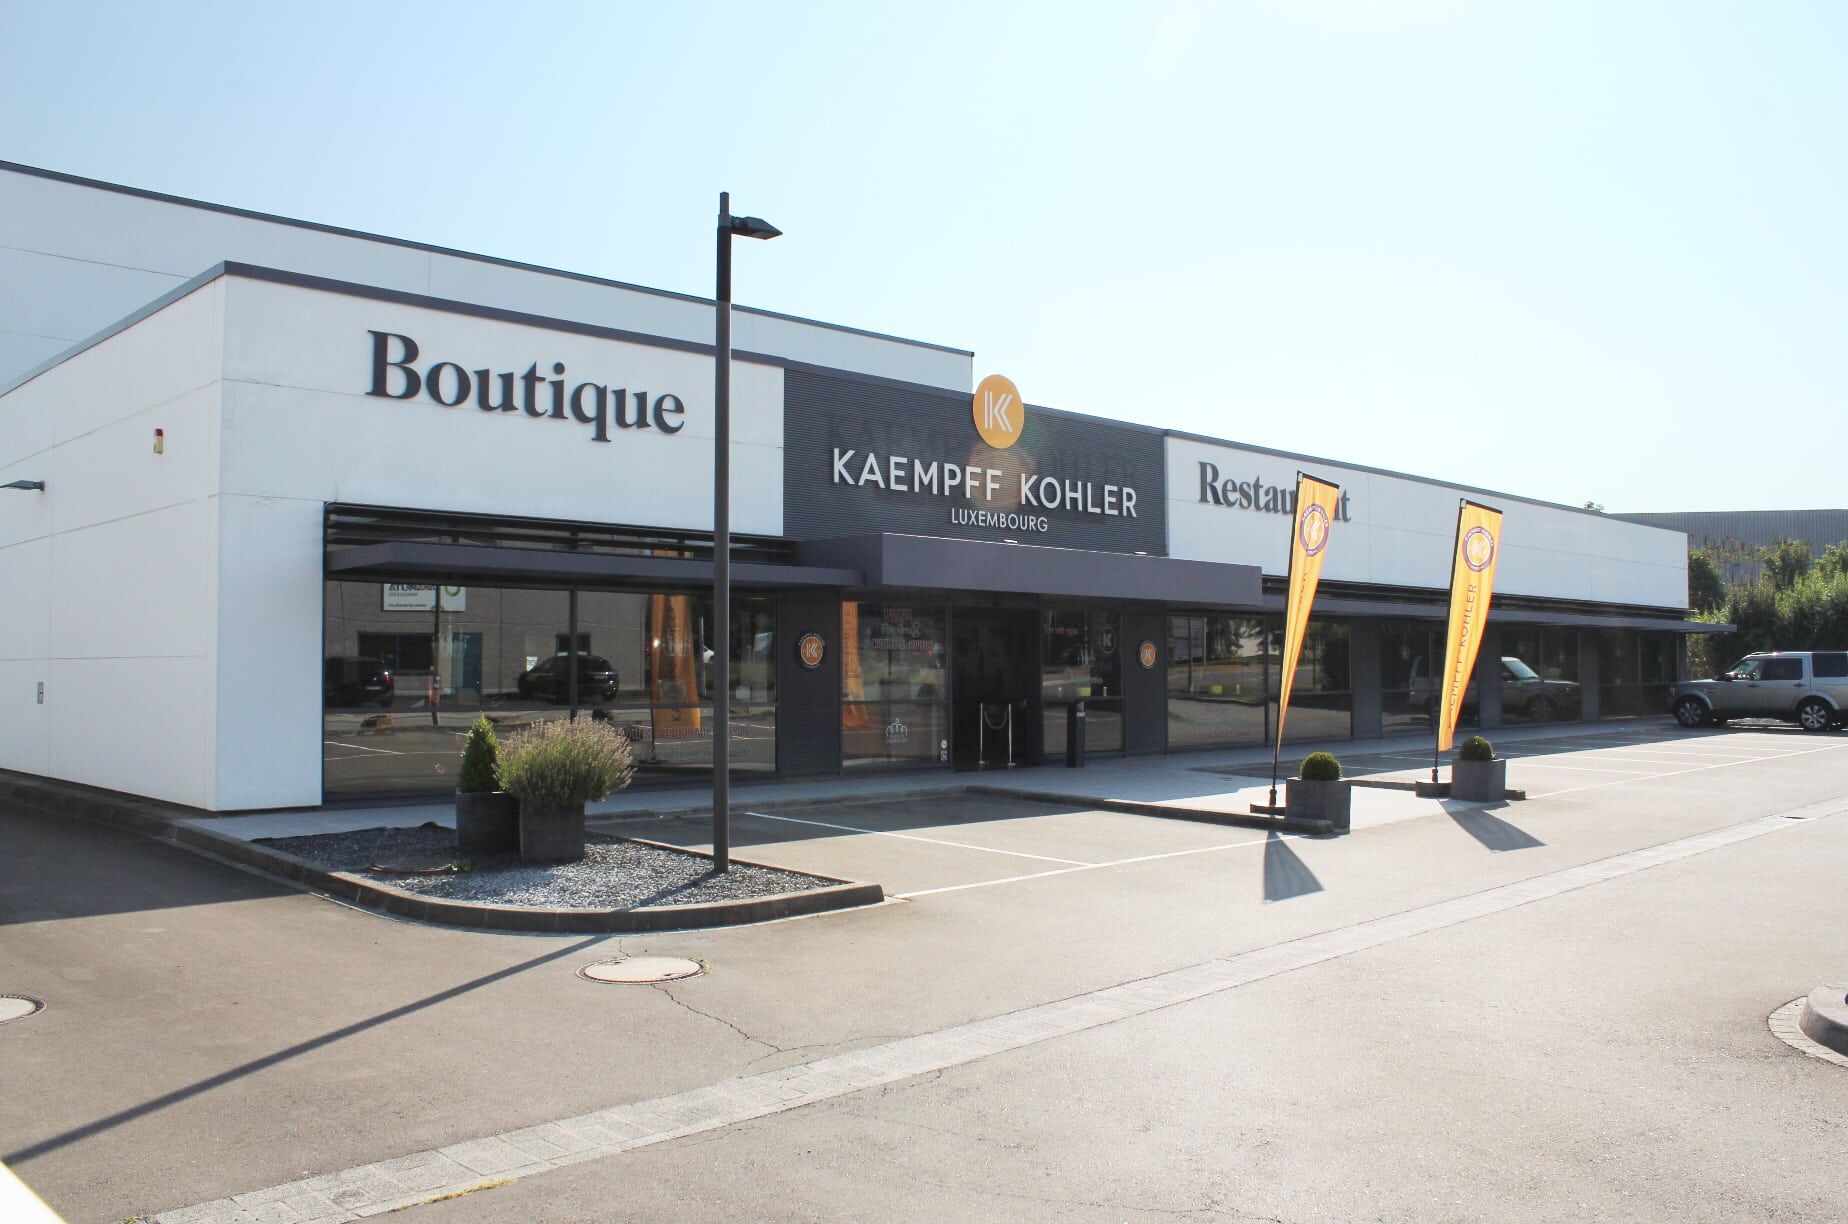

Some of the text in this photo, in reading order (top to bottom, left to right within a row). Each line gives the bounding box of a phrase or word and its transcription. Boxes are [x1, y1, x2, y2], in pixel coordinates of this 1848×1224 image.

[365, 329, 685, 443] Boutique
[832, 447, 1137, 518] KAEMPFF KOHLER
[1198, 460, 1352, 523] Restaut
[951, 507, 1049, 532] LUXEMBOURG
[1459, 583, 1477, 648] KOHLER
